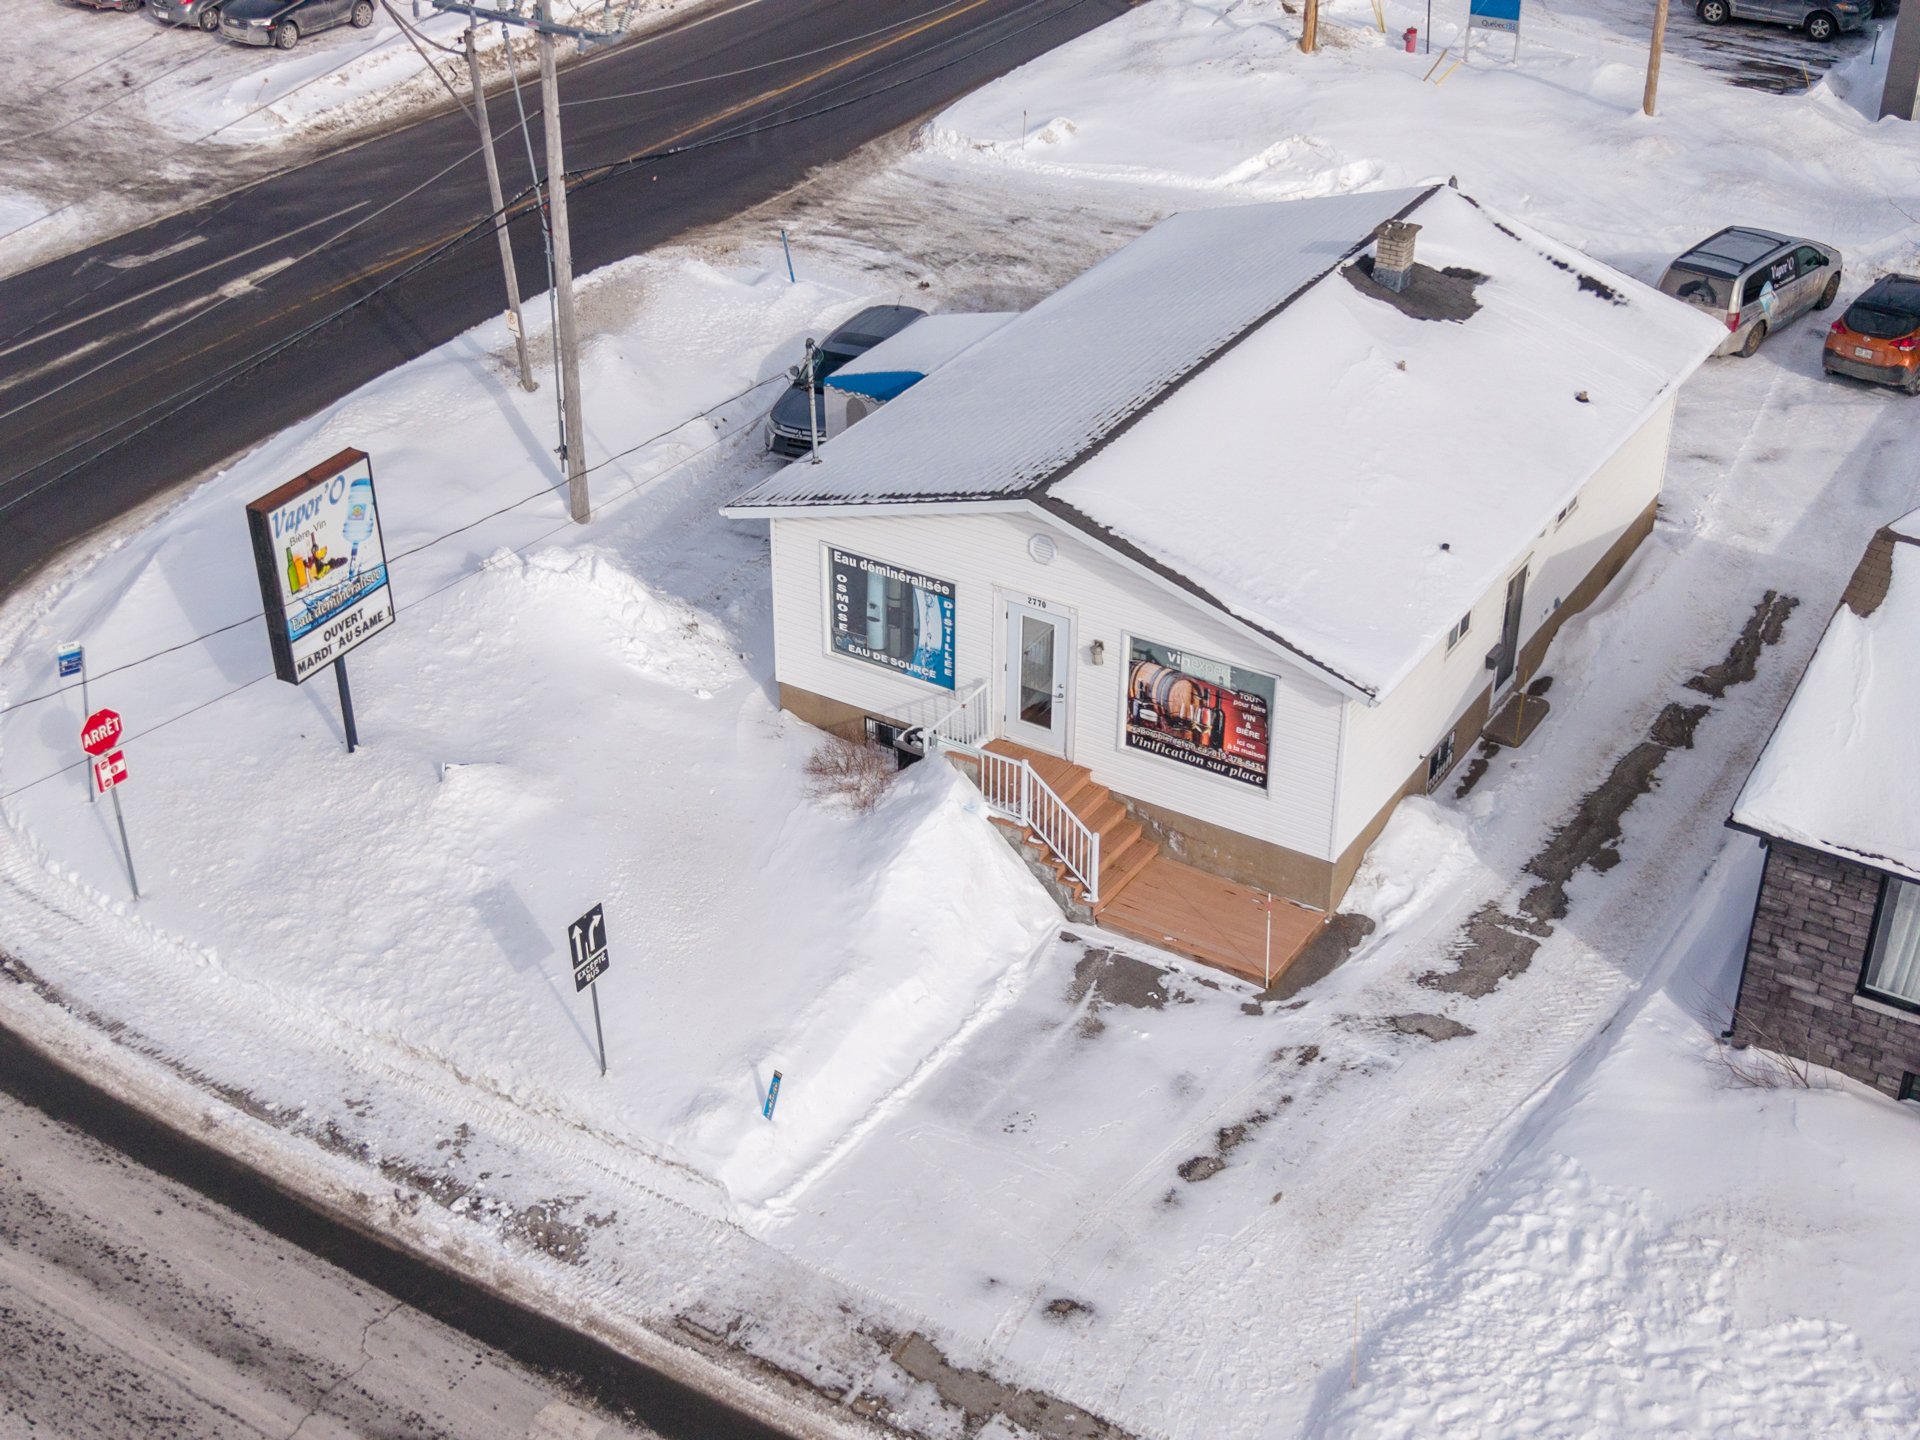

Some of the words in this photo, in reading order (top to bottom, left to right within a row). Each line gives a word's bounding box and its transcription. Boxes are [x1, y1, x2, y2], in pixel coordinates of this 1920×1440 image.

[272, 474, 346, 539] Vapor'O
[289, 530, 311, 547] Bière
[313, 520, 327, 532] Vin
[834, 551, 857, 567] Eau
[860, 559, 950, 595] déminéralisée
[836, 574, 849, 632] OSMOSE
[323, 608, 364, 642] OUVERT
[297, 645, 333, 675] MARDI
[338, 631, 353, 650] AU
[848, 644, 870, 658] EAU
[873, 653, 888, 664] DE
[890, 658, 937, 679] SOURCE
[84, 717, 121, 749] ARRÊT
[1242, 713, 1256, 723] VIN
[1131, 734, 1204, 766] Vinification
[1206, 760, 1228, 772] sur
[1229, 767, 1264, 784] place
[586, 966, 600, 982] BUS
